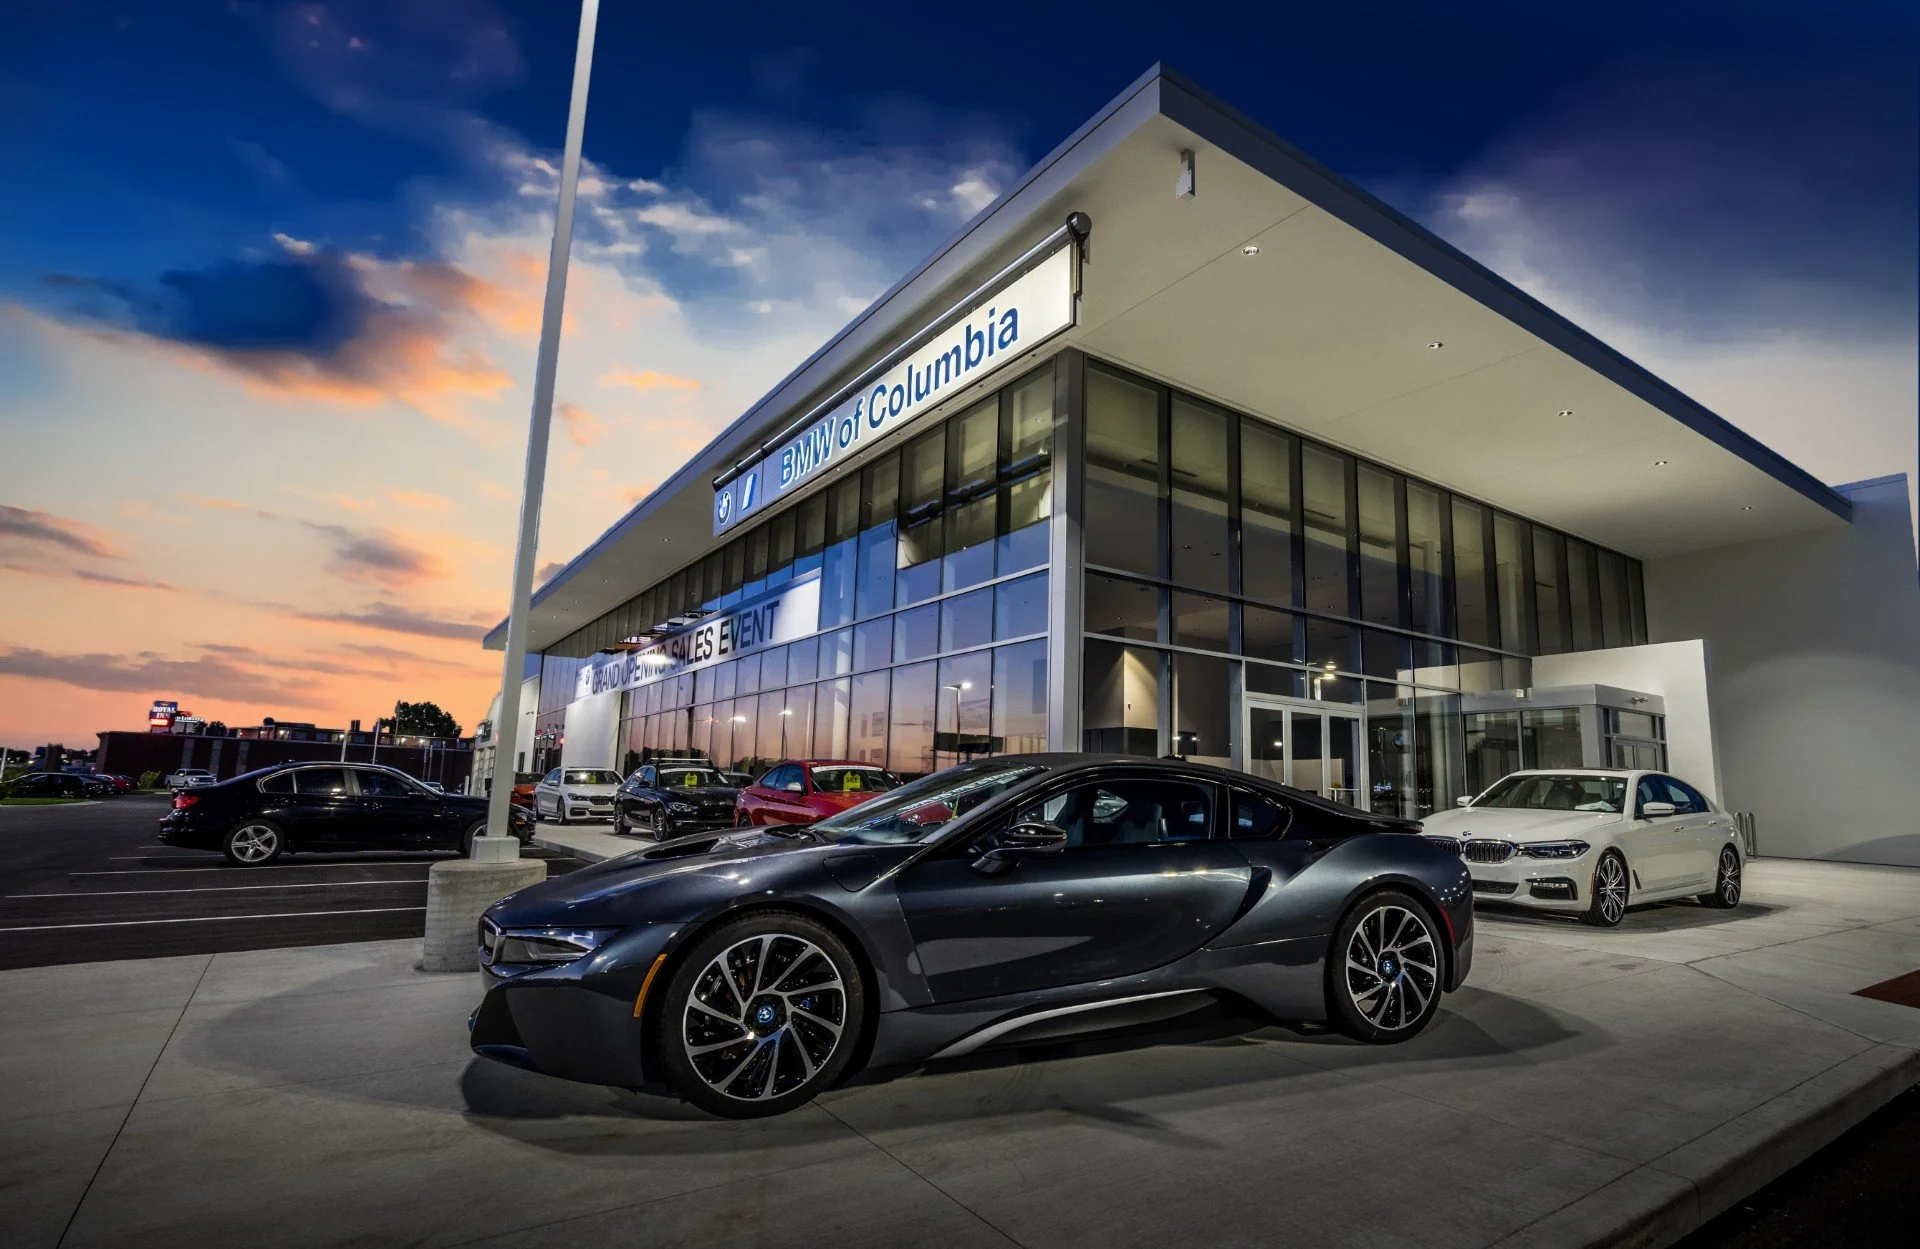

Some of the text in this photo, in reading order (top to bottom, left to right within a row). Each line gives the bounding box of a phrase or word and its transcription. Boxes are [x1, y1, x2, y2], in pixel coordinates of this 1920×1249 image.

[780, 304, 1019, 489] BMW of Columbia
[592, 663, 620, 695] GRAND
[671, 626, 714, 671] SALES
[719, 600, 780, 655] EVENT
